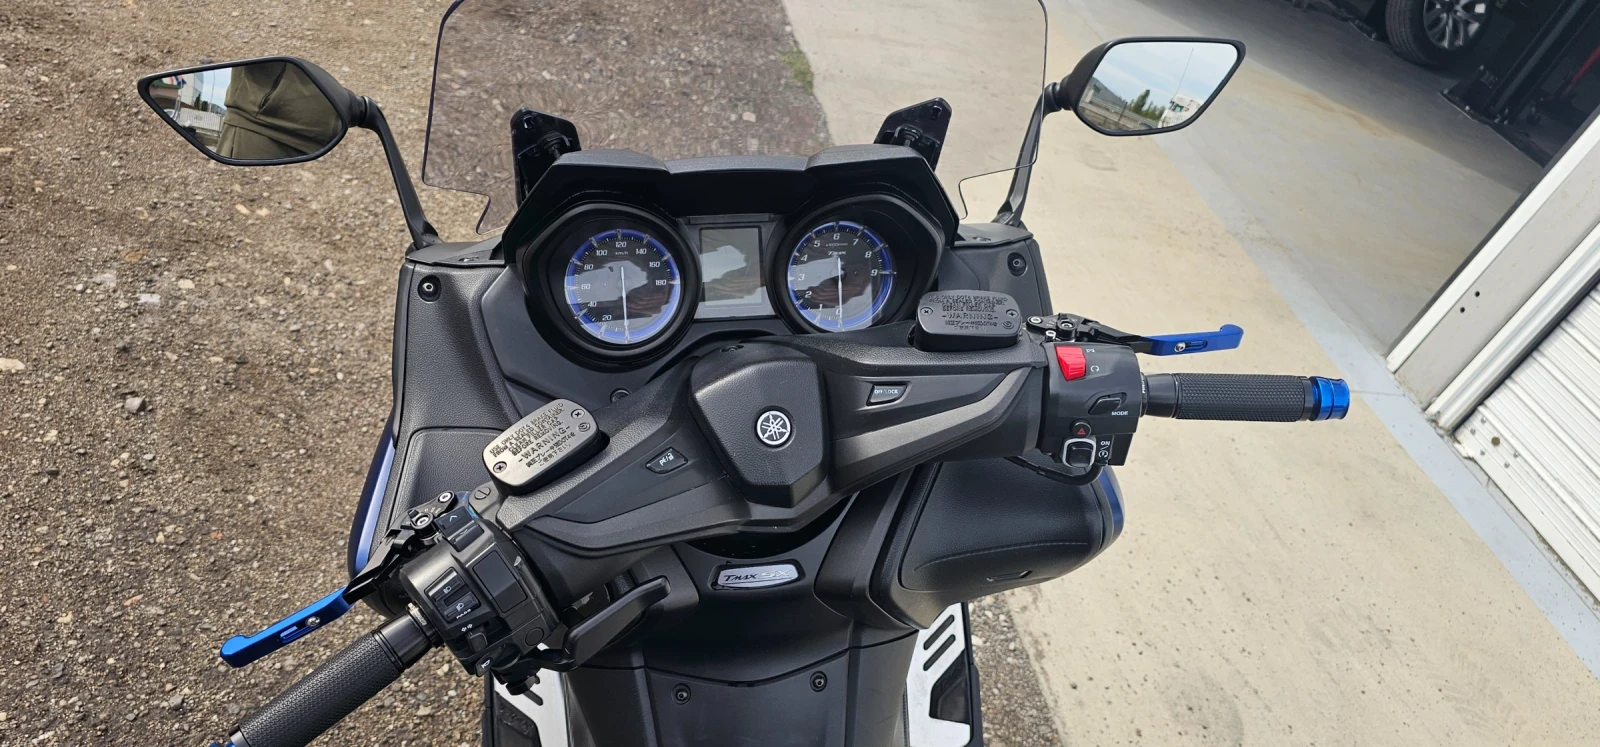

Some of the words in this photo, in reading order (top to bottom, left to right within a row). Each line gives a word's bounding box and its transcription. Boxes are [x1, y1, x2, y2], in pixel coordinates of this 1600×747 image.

[864, 251, 872, 259] 8
[798, 273, 805, 281] 3
[804, 291, 812, 299] 2
[489, 444, 500, 453] USE
[723, 573, 758, 582] TMAX
